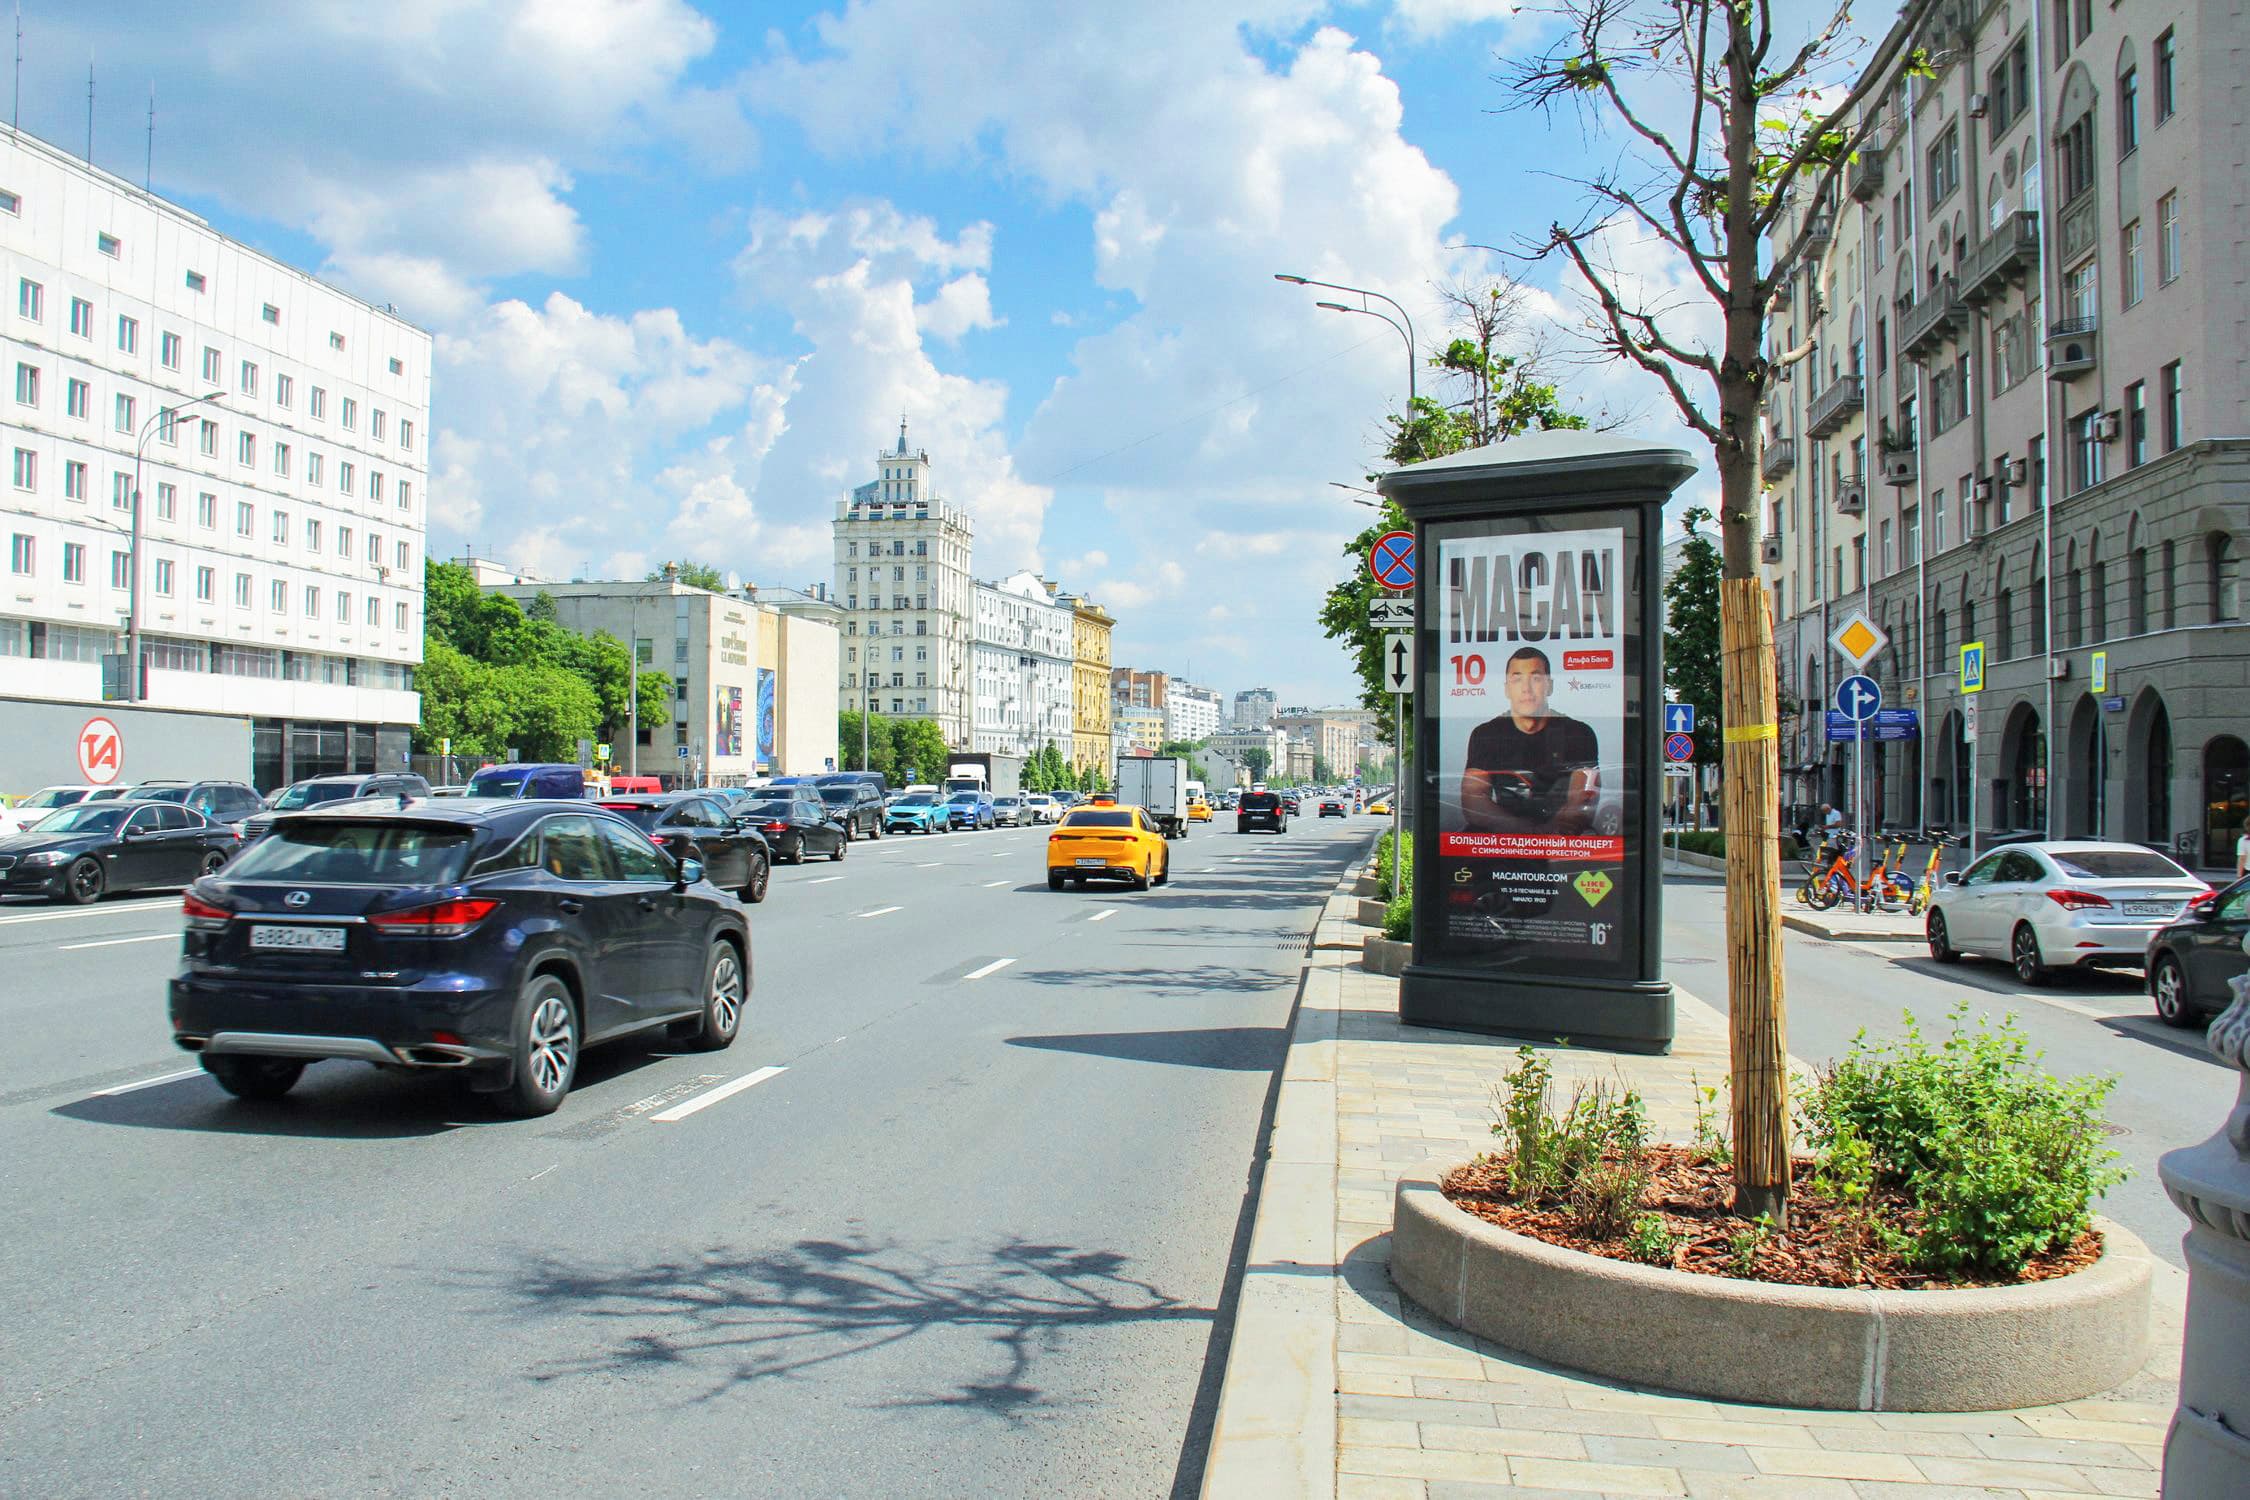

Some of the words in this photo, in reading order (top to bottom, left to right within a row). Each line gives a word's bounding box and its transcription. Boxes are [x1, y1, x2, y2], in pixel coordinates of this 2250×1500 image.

[1450, 549, 1614, 643] MACAN
[1567, 655, 1590, 665] Альфа
[1591, 655, 1609, 663] Банк
[1450, 654, 1486, 685] 10
[1450, 687, 1487, 697] АВГУСТА
[1450, 835, 1498, 846] БОЛЬШОЙ
[1499, 836, 1567, 848] СТАДИОННЫЙ
[1569, 839, 1614, 849] КОНЦЕРТ
[1478, 847, 1545, 856] СИМФОНИЧЕСКИМ
[1545, 849, 1591, 857] ОРКЕСТРОМ
[1492, 871, 1568, 883] MACANTOUR.COM
[1580, 880, 1606, 888] LIKE
[1589, 922, 1613, 945] 16+
